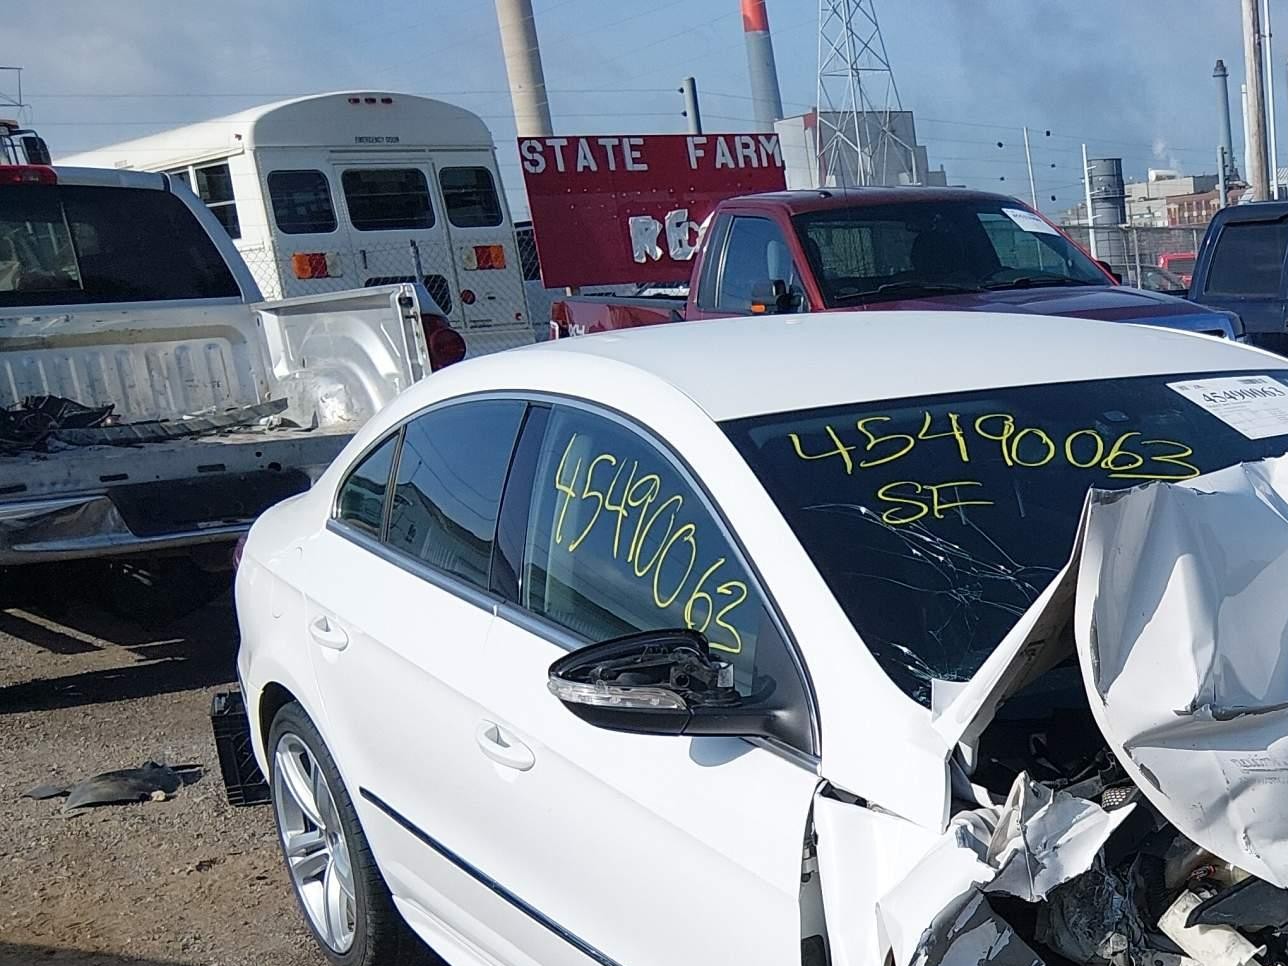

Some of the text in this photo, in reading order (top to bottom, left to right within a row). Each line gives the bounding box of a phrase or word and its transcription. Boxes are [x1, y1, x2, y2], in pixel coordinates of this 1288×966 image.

[520, 136, 783, 174] STATE FARM
[1202, 386, 1287, 403] 45490063
[787, 411, 1201, 480] 45490063
